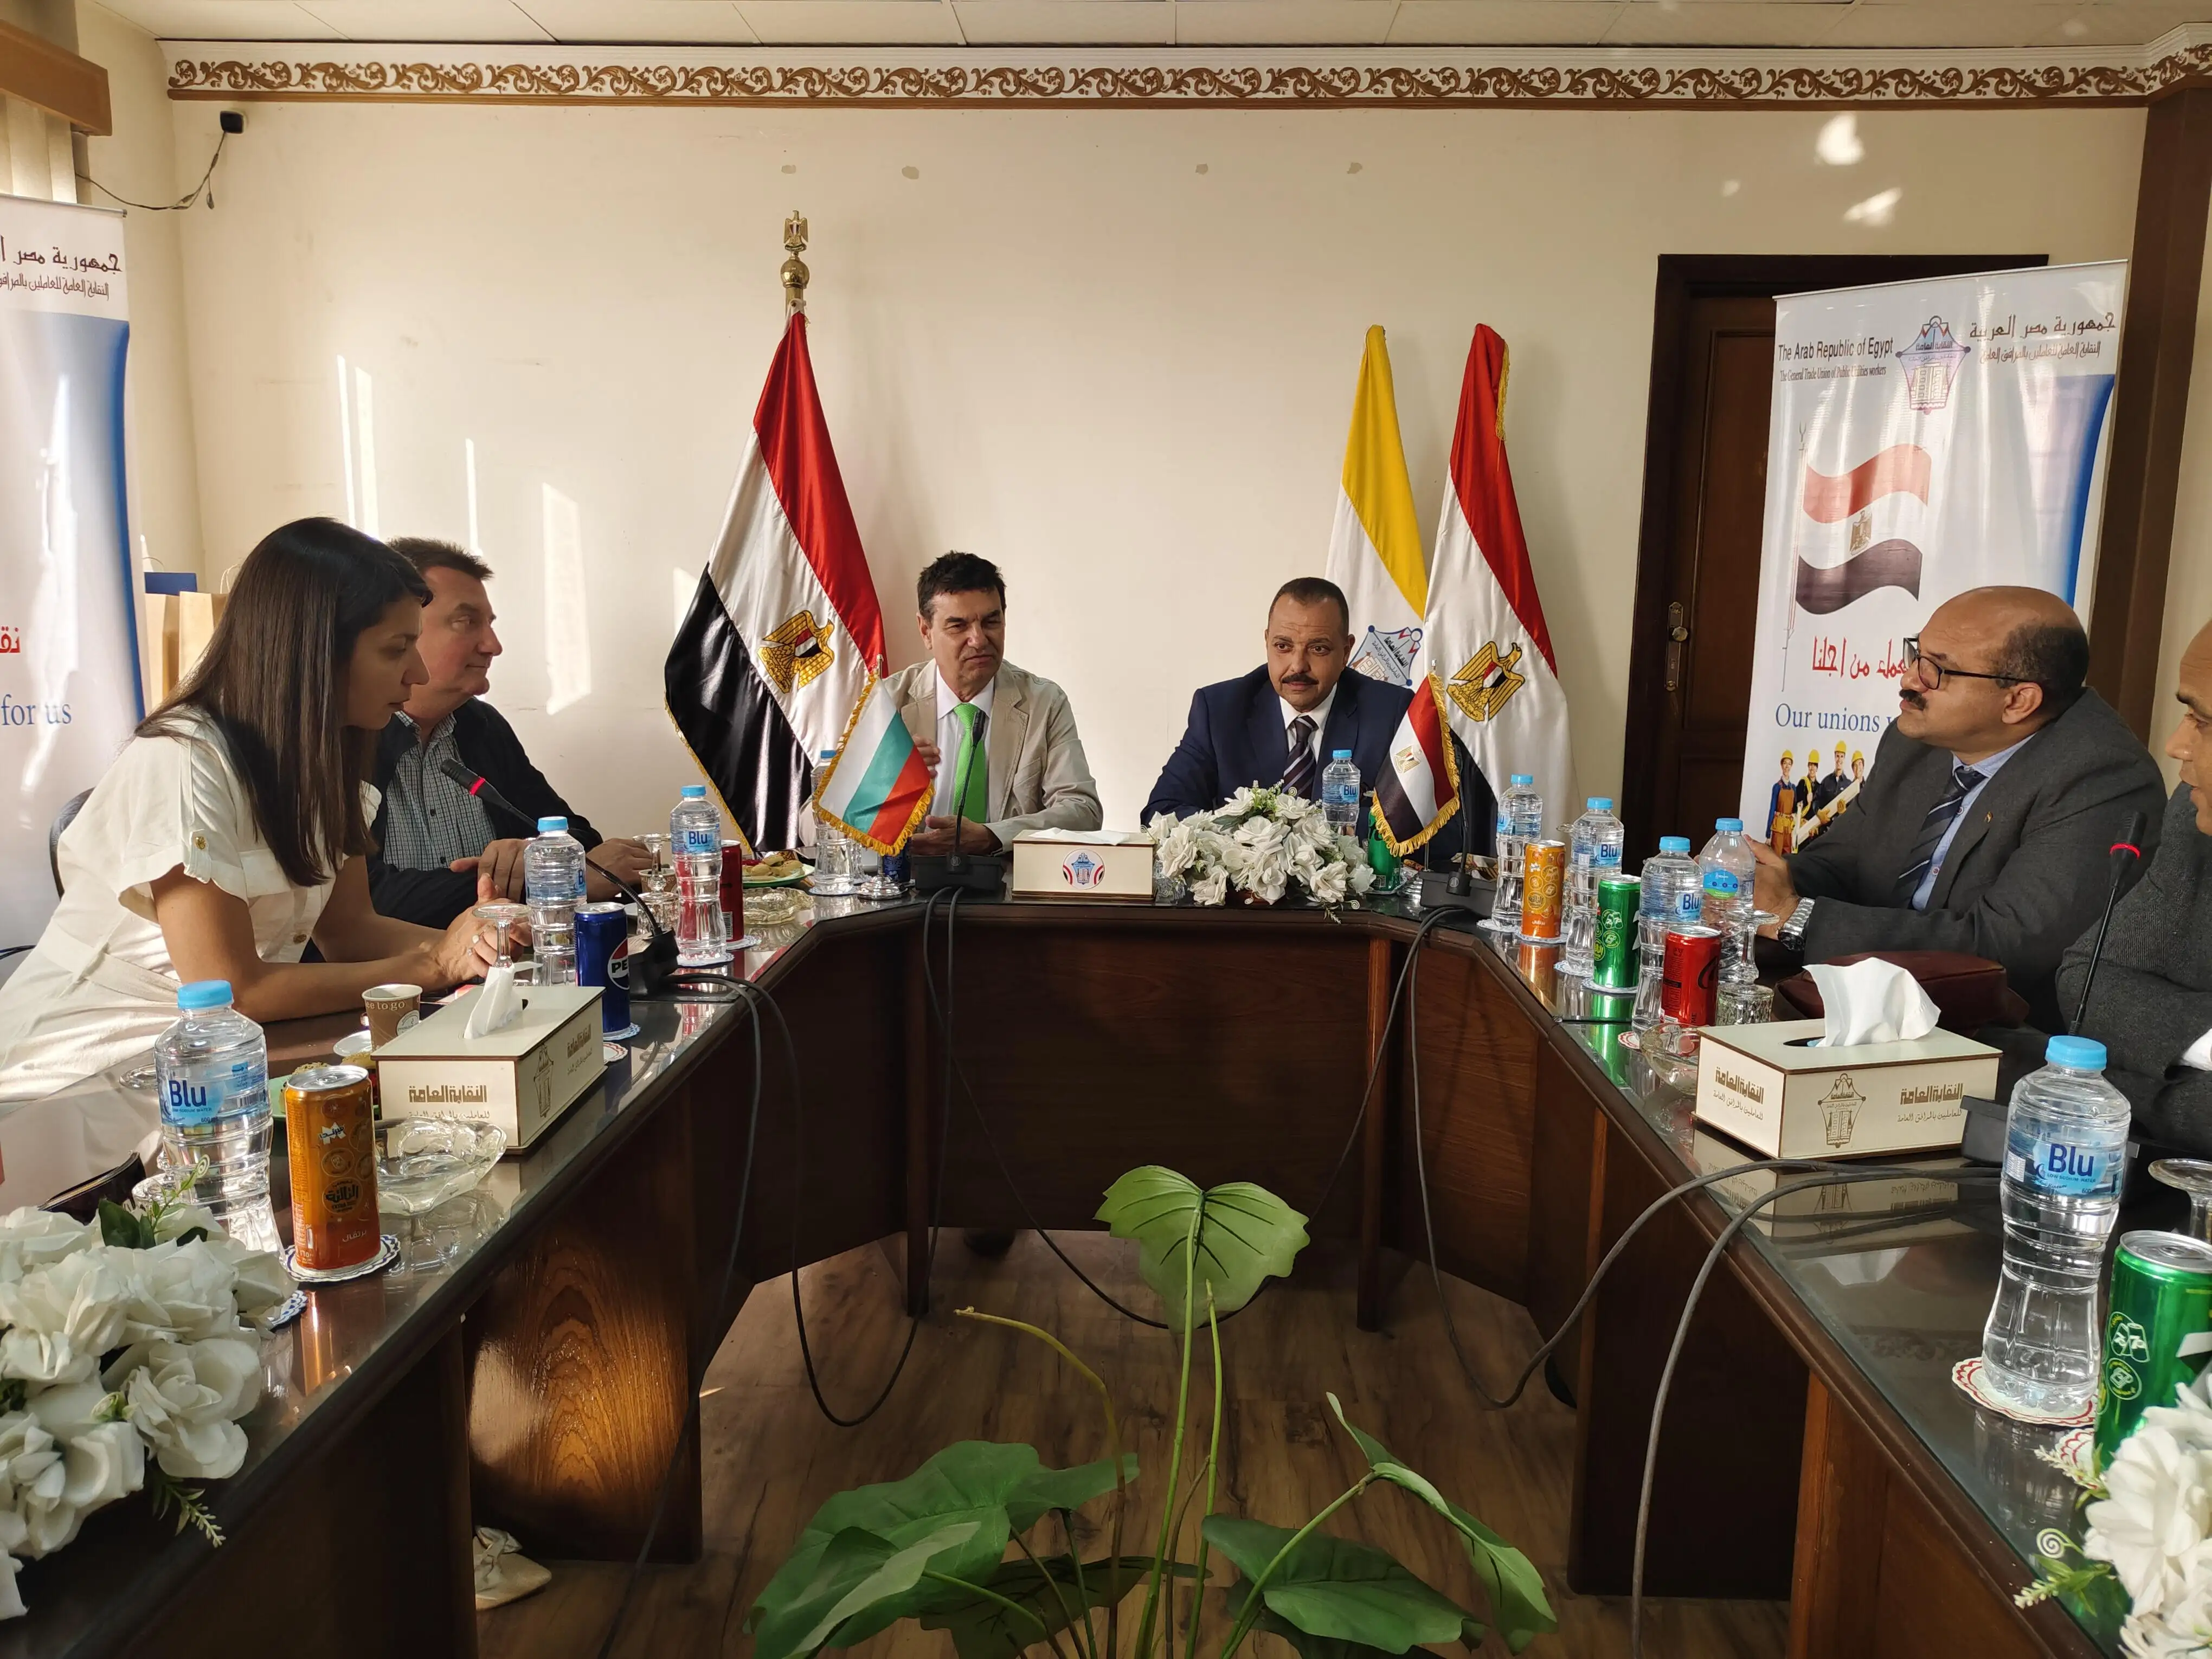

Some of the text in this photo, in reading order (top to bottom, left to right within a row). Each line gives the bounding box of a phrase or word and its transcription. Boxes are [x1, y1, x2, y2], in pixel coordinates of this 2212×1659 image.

[13, 246, 123, 275] جمهورية مصر
[28, 273, 62, 291] للعاملين
[62, 277, 86, 298] العامة
[87, 281, 110, 301] النقابة
[1969, 312, 2115, 342] جمهورية مصر العربية
[1778, 344, 1792, 361] The
[1793, 342, 1814, 360] Arab
[1816, 339, 1854, 362] Republic
[1857, 338, 1867, 356] of
[1868, 337, 1894, 359] Egypt
[2079, 340, 2101, 358] النقابة
[1850, 653, 1870, 679] من
[0, 694, 72, 726] for us
[1775, 703, 1812, 728] Our
[1817, 708, 1880, 733] unions
[1343, 785, 1356, 796] Blu
[689, 831, 708, 845] Blu
[1600, 844, 1617, 858] Blu
[1682, 893, 1700, 910] Blu
[391, 1001, 406, 1011] go
[168, 1079, 207, 1108] Blu
[409, 1084, 487, 1104] النقابة العامة
[1715, 1066, 1764, 1105] النقابة العامة
[1900, 1083, 1963, 1105] النقابة العامة
[2048, 1143, 2094, 1177] Blu
